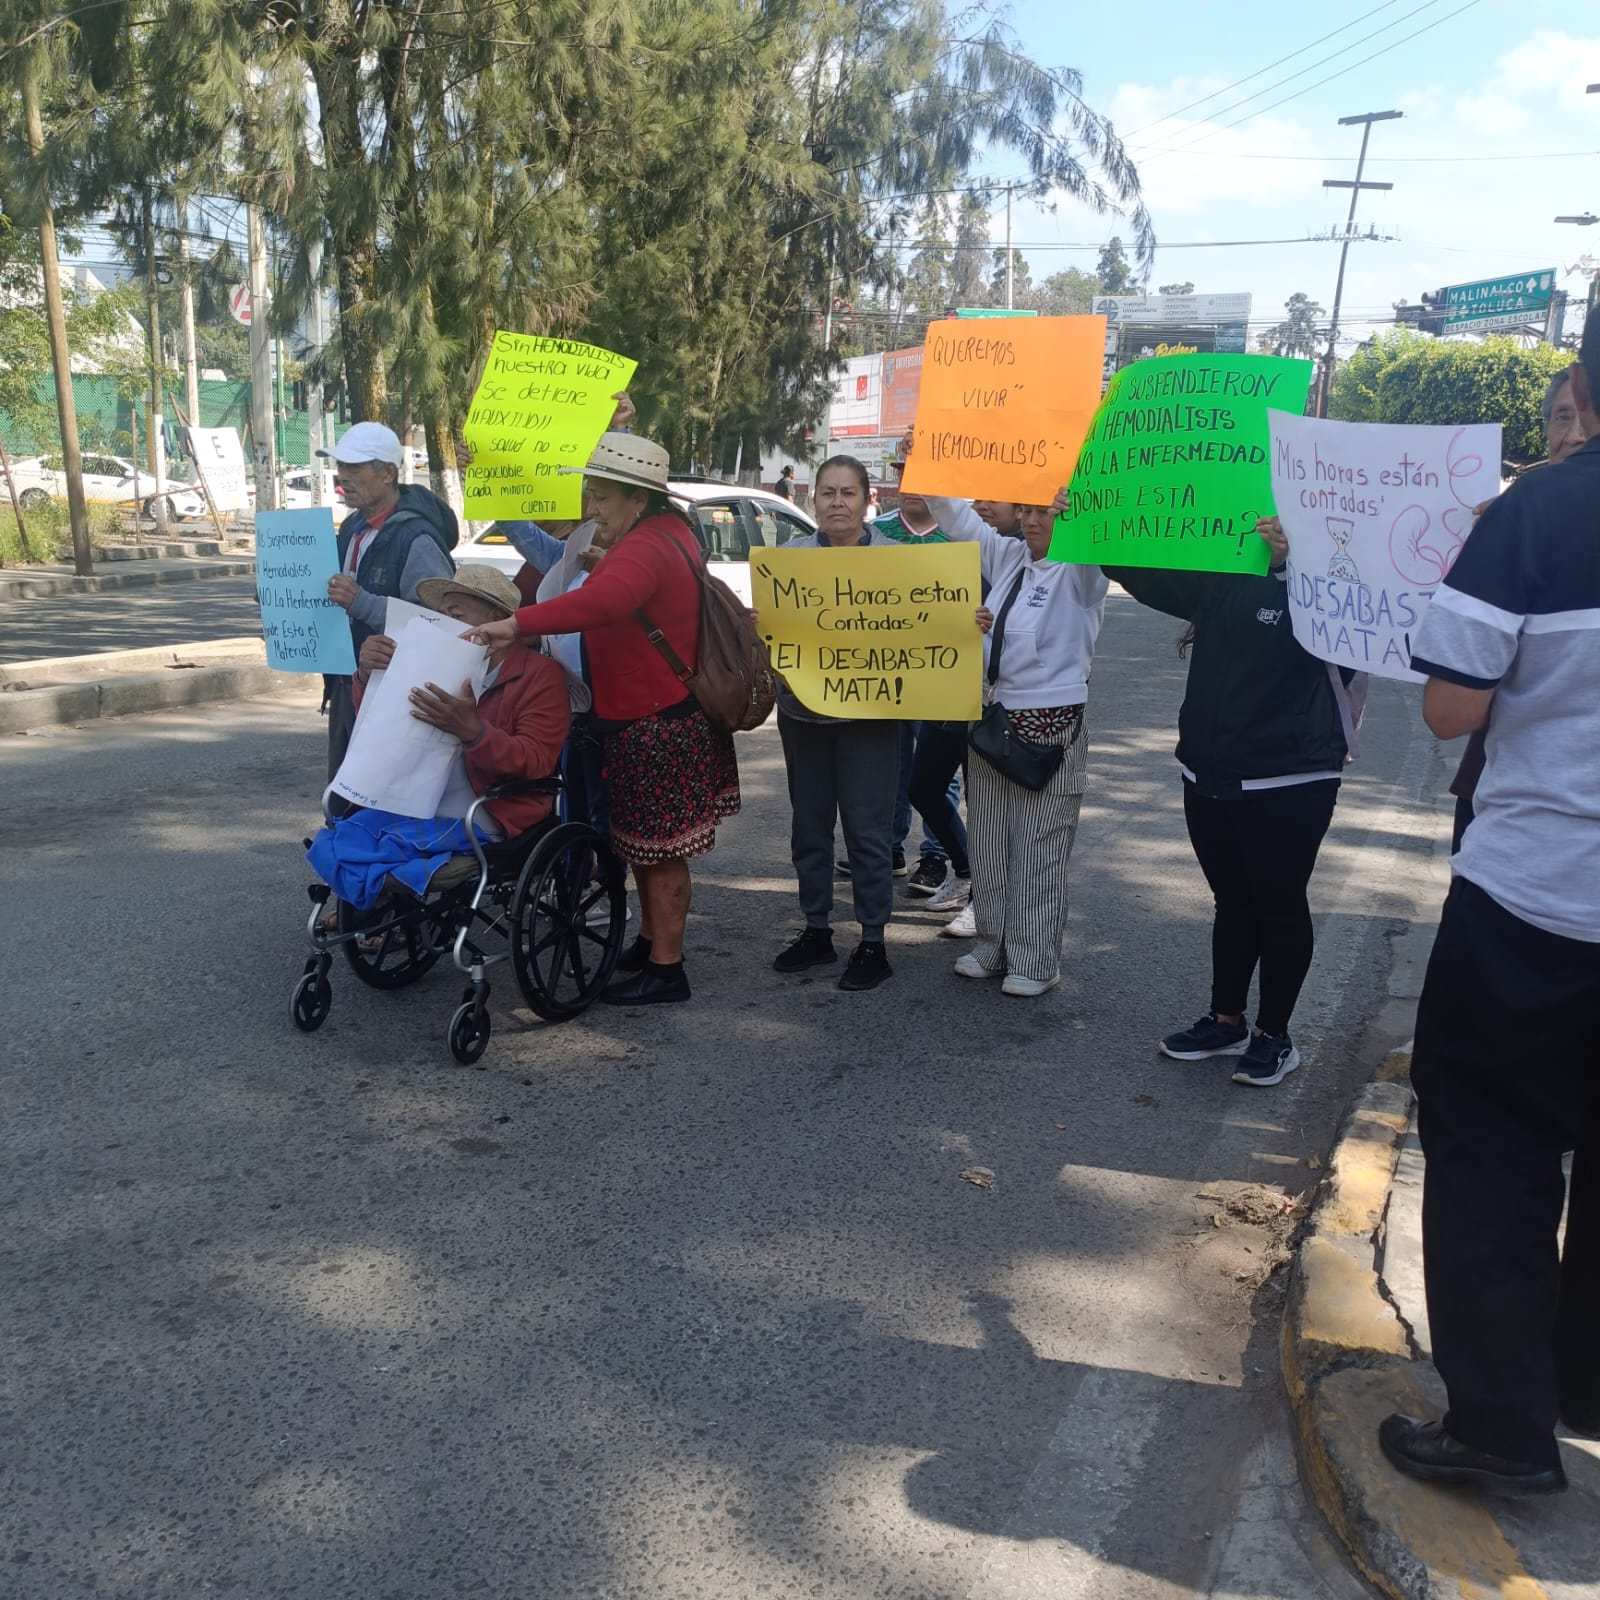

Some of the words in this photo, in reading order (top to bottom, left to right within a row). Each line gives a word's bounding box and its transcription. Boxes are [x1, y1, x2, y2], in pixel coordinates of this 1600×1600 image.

[1449, 281, 1524, 304] MALINALCO
[1471, 297, 1524, 315] TOLUCA
[1445, 320, 1481, 333] DESPACIO
[1484, 317, 1505, 327] ZONA
[1507, 311, 1547, 323] ESCOLAR
[496, 333, 530, 356] Sin
[518, 381, 588, 406] detiene
[1128, 368, 1284, 401] SUSPENDIERON
[1102, 403, 1236, 443] HEMODIALISIS
[211, 435, 225, 459] E
[489, 436, 526, 453] salud
[533, 440, 550, 453] no
[559, 443, 579, 453] es
[1100, 451, 1120, 476] LA
[1314, 441, 1369, 486] horas
[1379, 451, 1440, 488] están
[1136, 484, 1196, 509] ESTA
[1092, 522, 1112, 545] EL
[1120, 510, 1261, 556] MATERIAL?
[835, 576, 902, 607] Horas
[909, 580, 970, 604] estan
[282, 619, 305, 639] Esta
[818, 645, 959, 671] DESABASTO
[823, 676, 904, 705] MATA!
